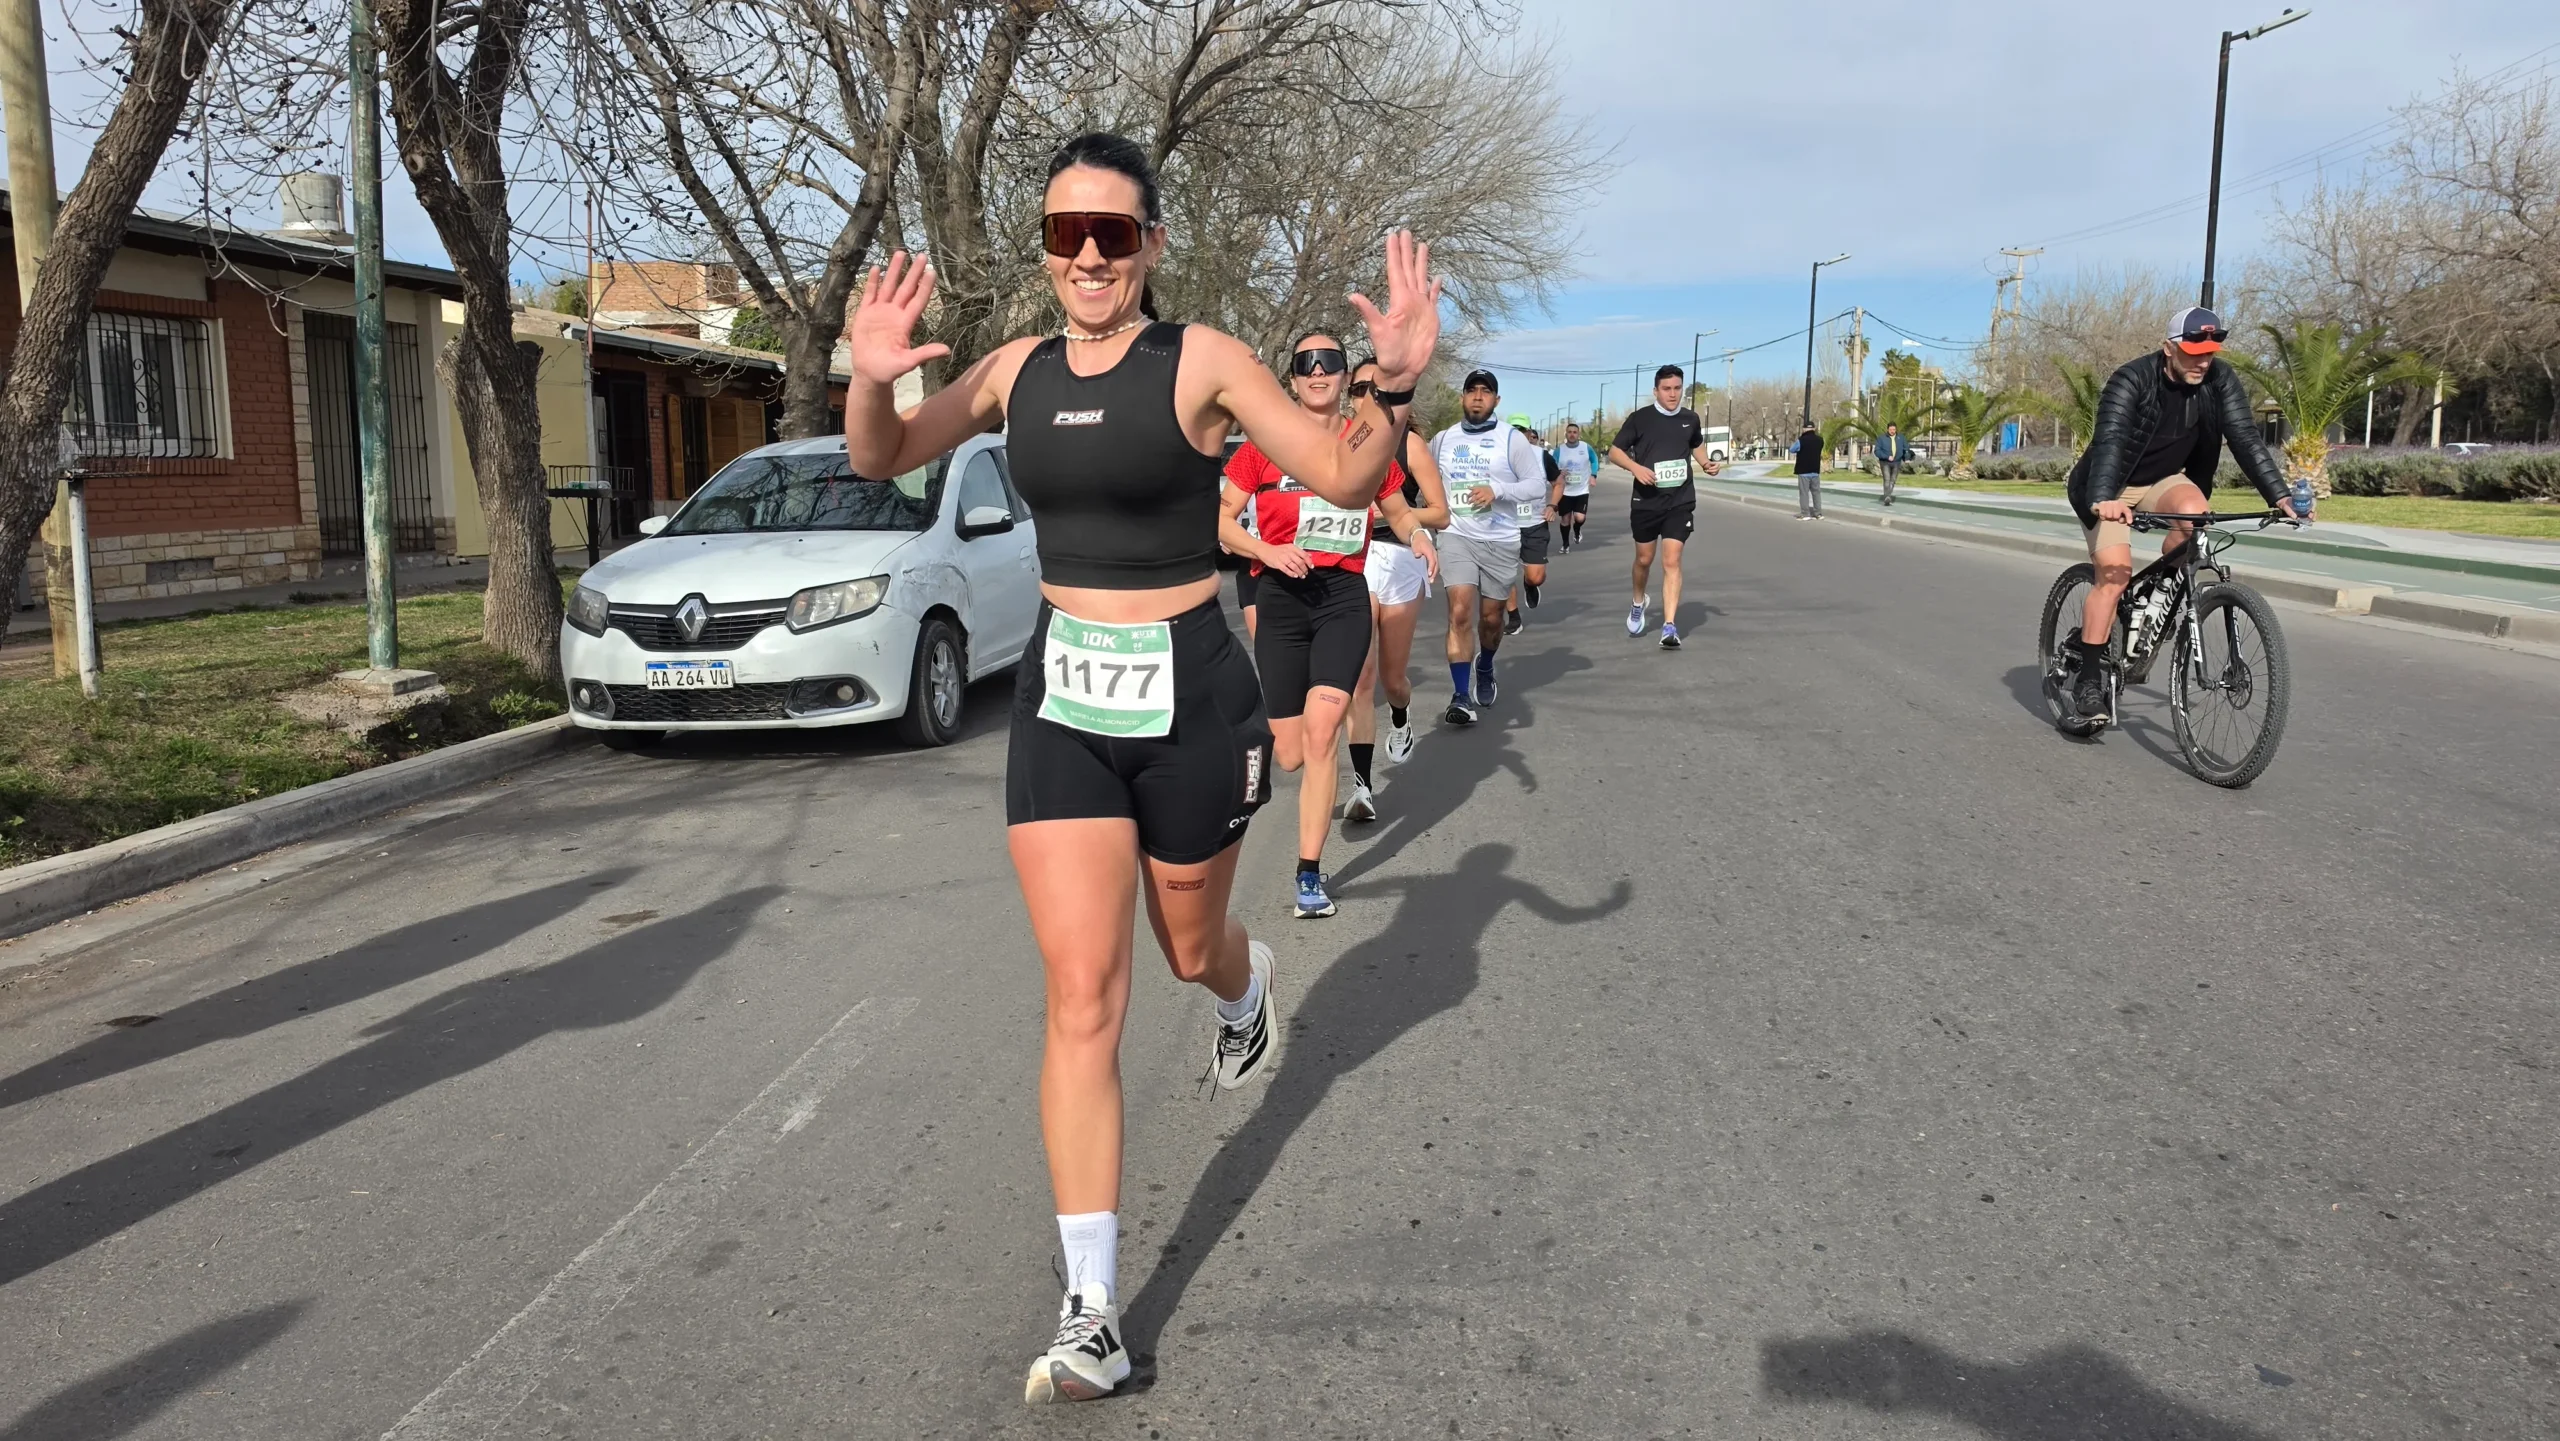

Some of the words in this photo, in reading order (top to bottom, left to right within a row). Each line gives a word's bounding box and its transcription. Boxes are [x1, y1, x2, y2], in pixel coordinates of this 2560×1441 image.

[1055, 411, 1103, 423] PUSH
[1349, 424, 1372, 450] PUSH
[1658, 468, 1685, 480] 1052
[1305, 516, 1363, 536] 1218
[1081, 630, 1119, 649] 10K
[651, 670, 671, 687] AA
[675, 670, 705, 686] 264
[1055, 653, 1160, 700] 1177
[1096, 717, 1141, 727] ALMONACID
[1245, 748, 1260, 802] PUSH
